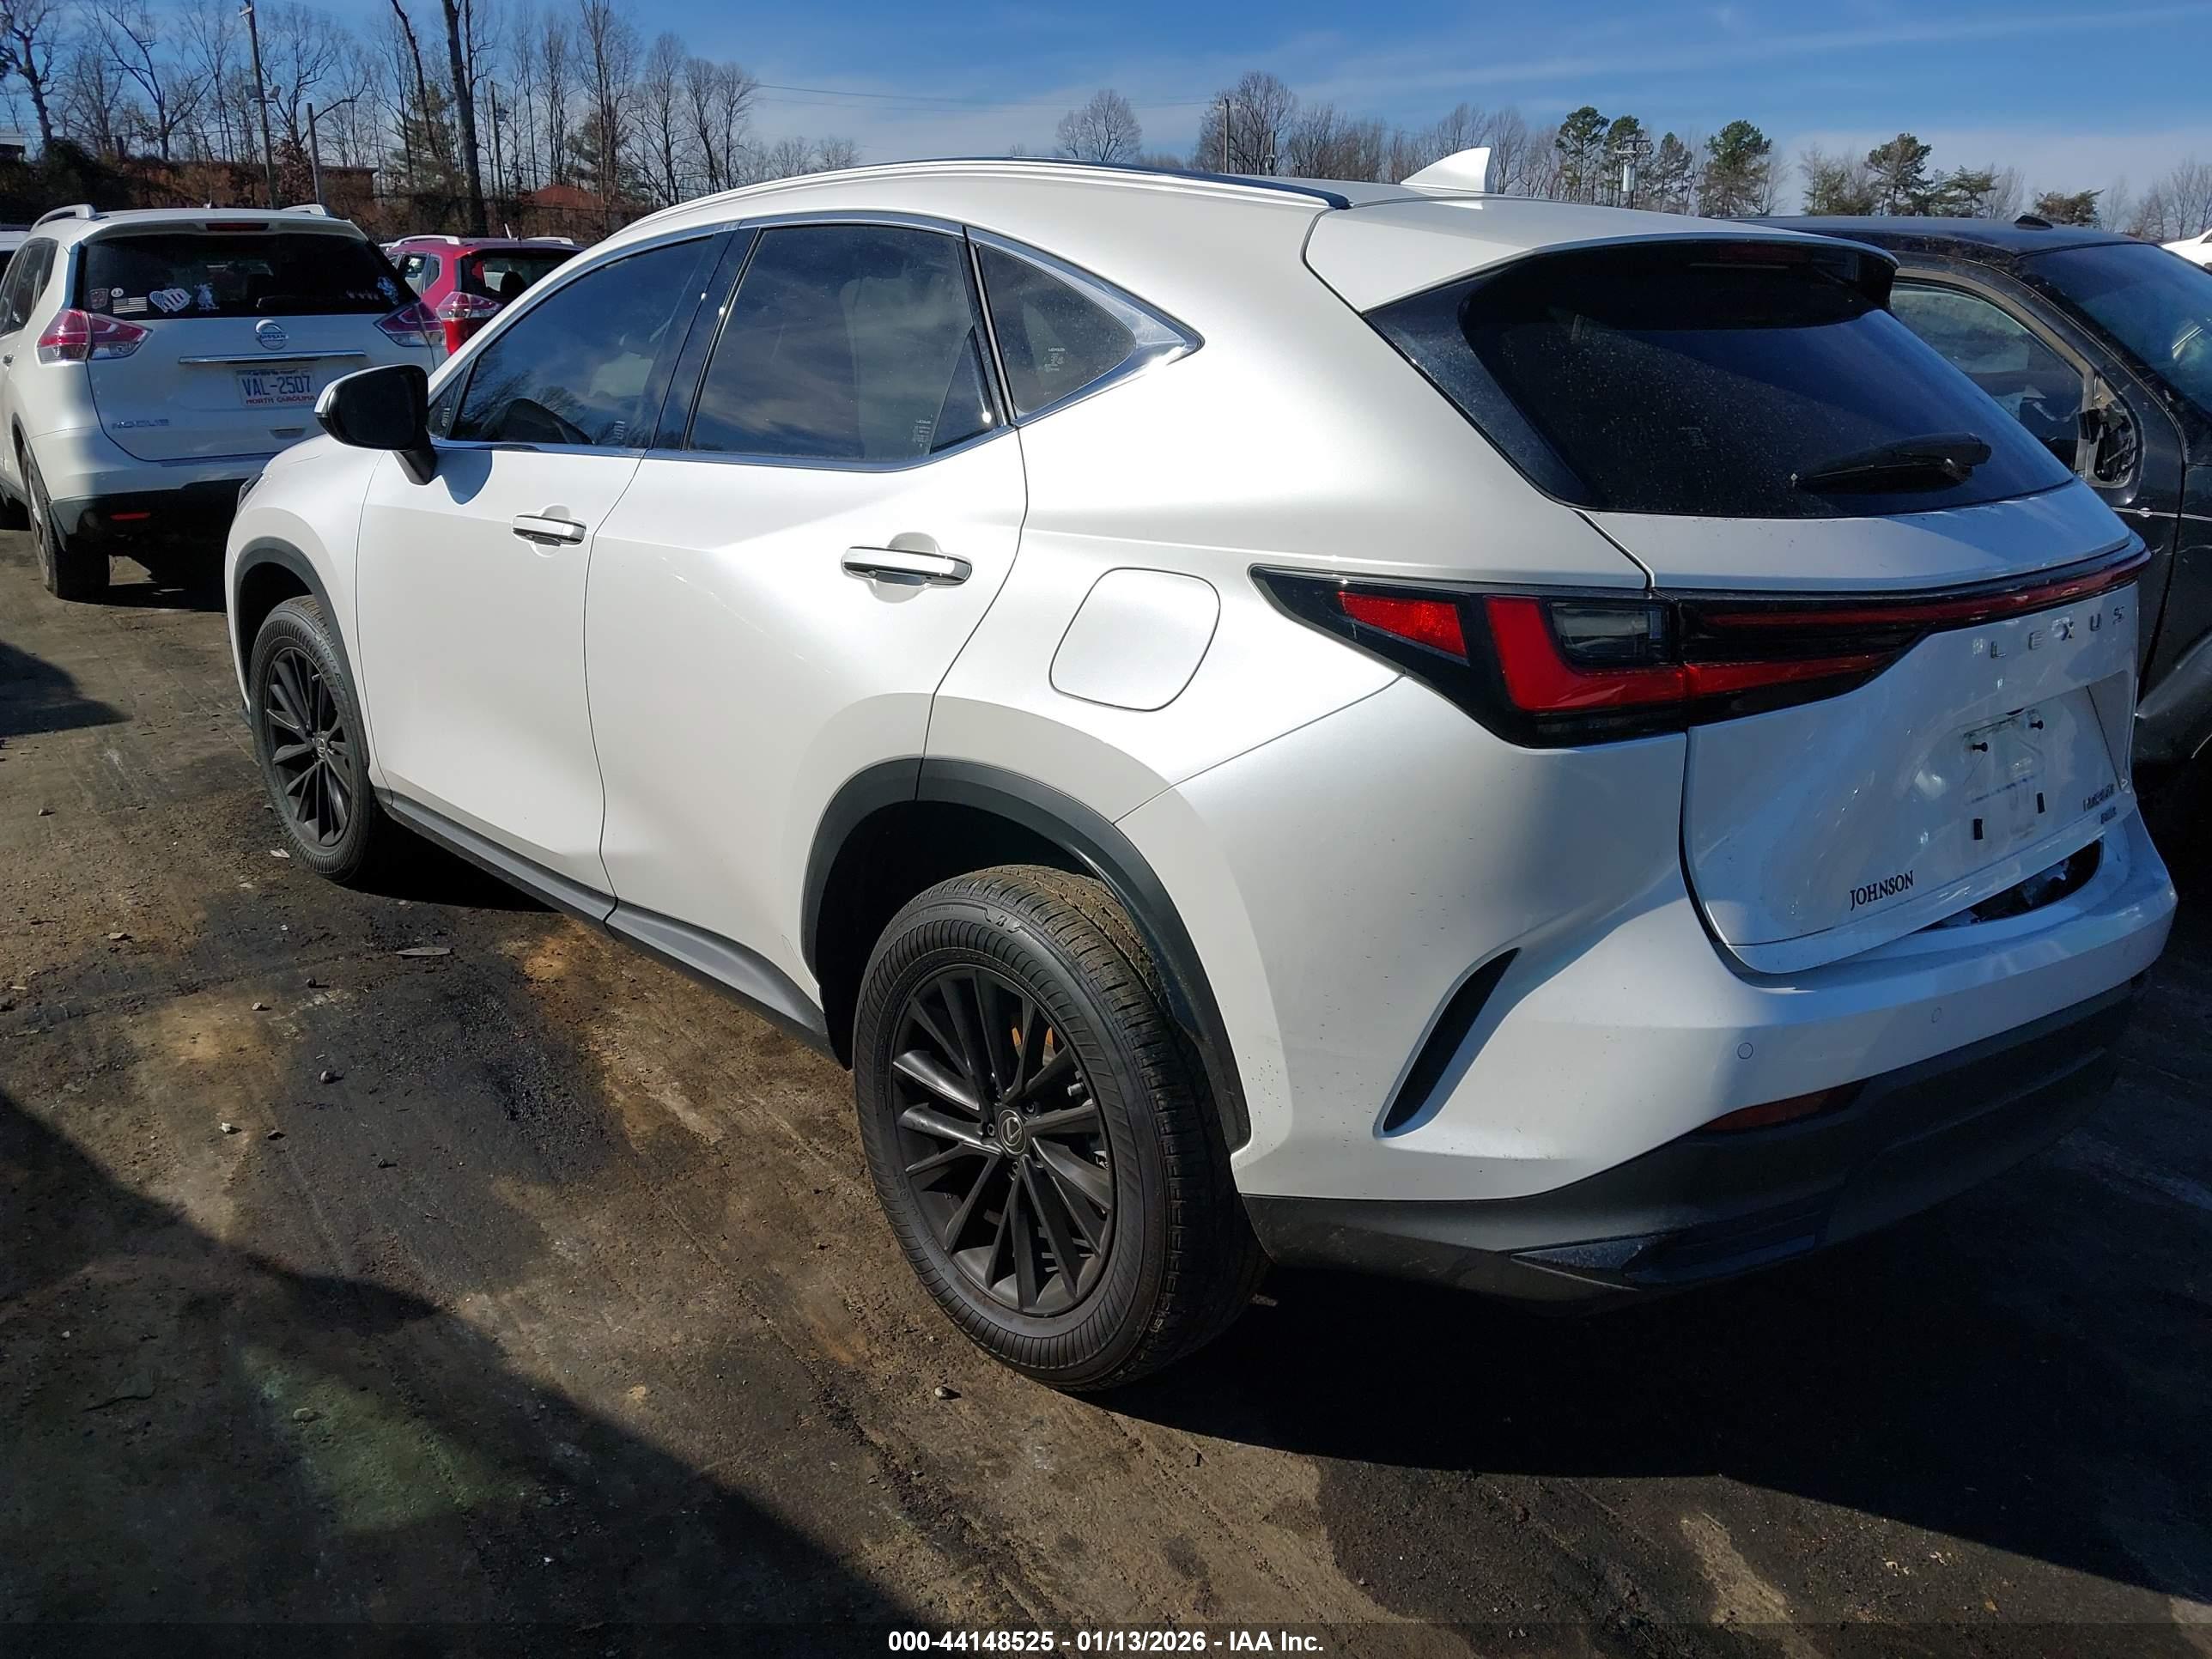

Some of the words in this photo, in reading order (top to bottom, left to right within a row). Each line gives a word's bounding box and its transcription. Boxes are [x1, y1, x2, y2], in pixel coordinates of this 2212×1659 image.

[241, 374, 312, 396] VAL-2507
[1990, 605, 2125, 659] LEXUS
[1850, 870, 1914, 911] JOHNSON
